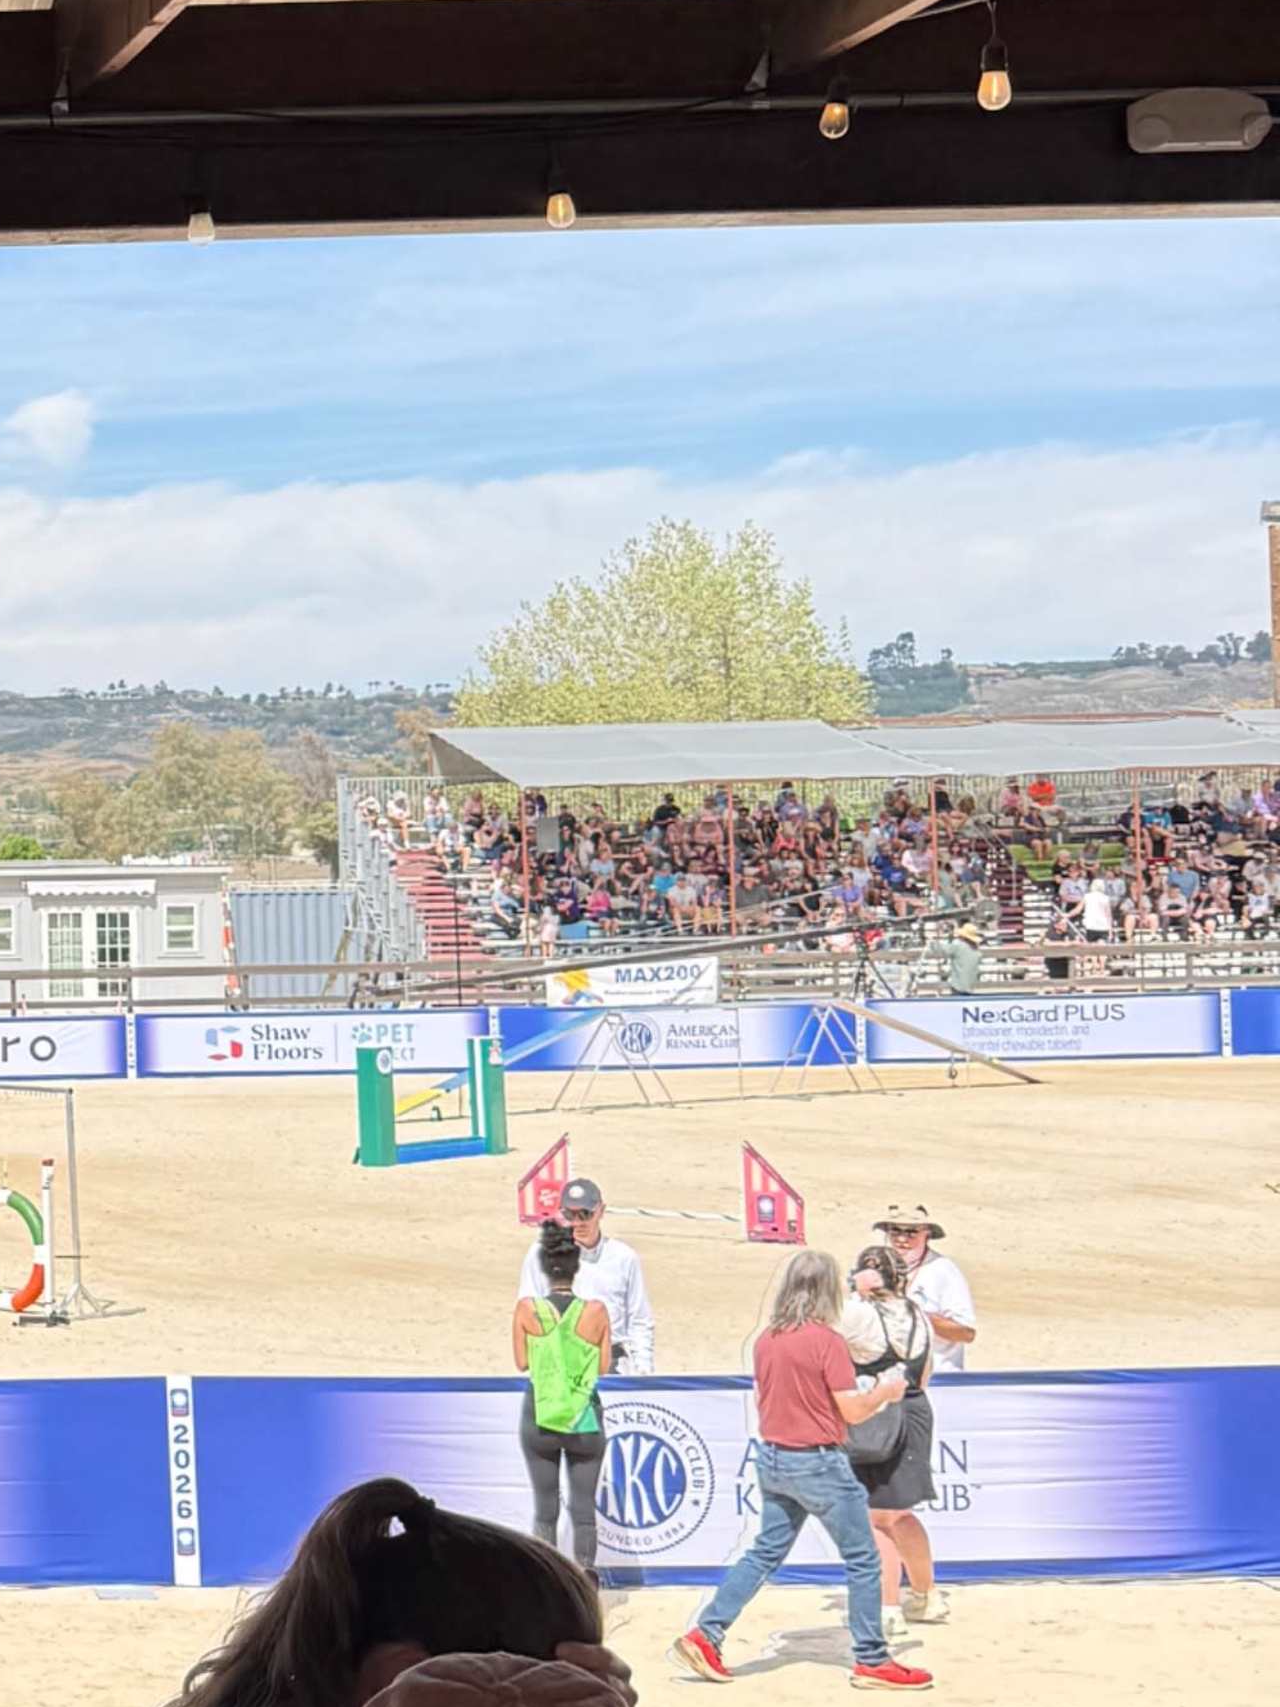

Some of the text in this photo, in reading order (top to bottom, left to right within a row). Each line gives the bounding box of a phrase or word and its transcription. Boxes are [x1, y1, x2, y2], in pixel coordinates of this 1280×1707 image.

[615, 963, 701, 984] MAX200
[962, 1004, 1126, 1023] NexGard PLUS
[251, 1023, 311, 1042] Shaw
[376, 1023, 415, 1043] PET
[253, 1042, 323, 1061] Floors
[622, 1410, 687, 1447] KENNEL
[684, 1445, 705, 1489] CLUB
[173, 1424, 193, 1519] 2026
[595, 1433, 683, 1527] AKC
